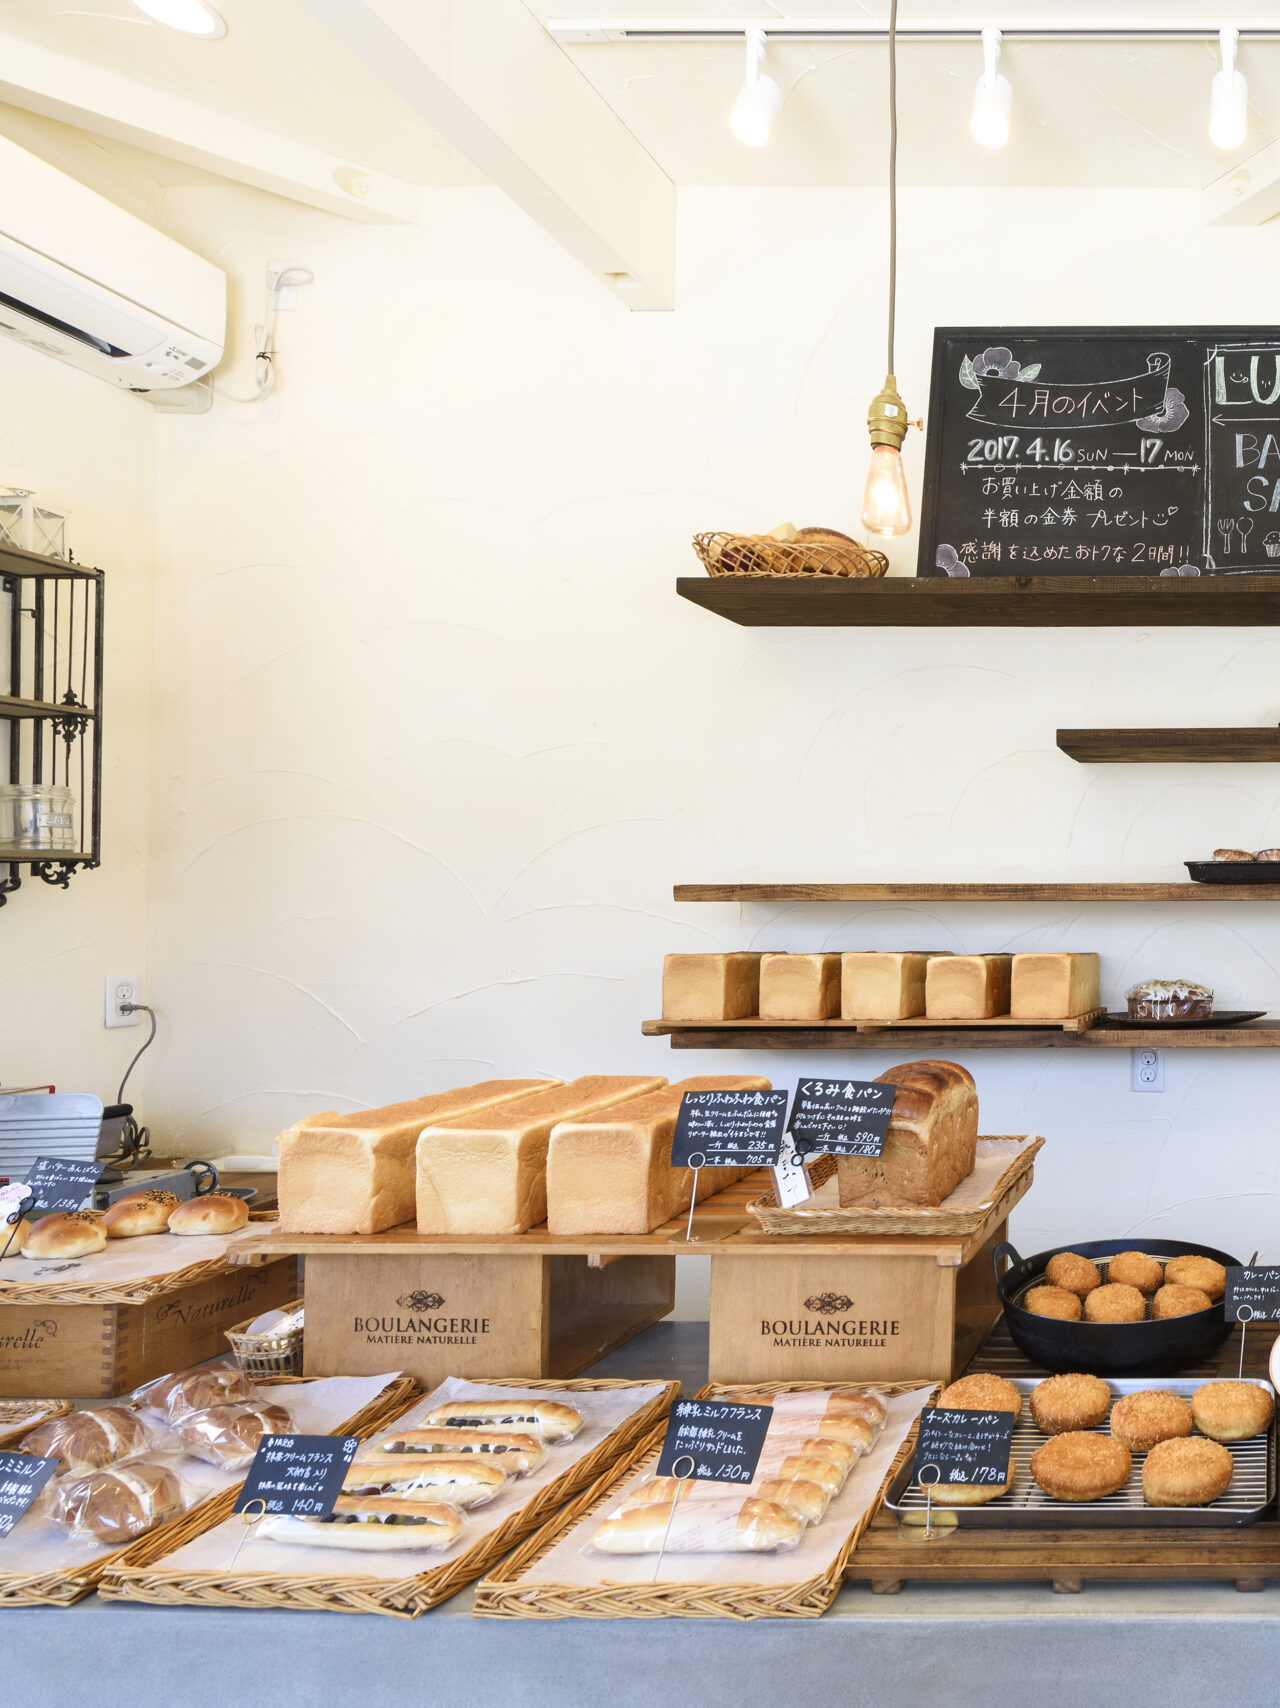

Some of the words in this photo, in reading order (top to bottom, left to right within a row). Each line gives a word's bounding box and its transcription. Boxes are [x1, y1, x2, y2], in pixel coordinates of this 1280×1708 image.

[999, 387, 1143, 418] 4月のイベント
[1077, 449, 1108, 463] SUN
[1164, 449, 1194, 462] MON
[982, 476, 1123, 501] お買い上げ金額の
[1087, 509, 1149, 528] プレゼント
[801, 1081, 883, 1100] くるみ食パン
[685, 1091, 786, 1106] しっとりふわふわ食パン
[854, 1131, 881, 1143] 590円
[747, 1140, 775, 1150] 235円
[746, 1155, 773, 1165] 705円
[1243, 1270, 1280, 1281] カレーパン
[354, 1317, 490, 1333] BOULANGERIE
[761, 1320, 900, 1335] BOULANGERIE
[926, 1410, 999, 1425] チーズカレーパン
[715, 1464, 751, 1480] 130円
[971, 1467, 1006, 1483] 178円
[291, 1498, 324, 1512] 140円
